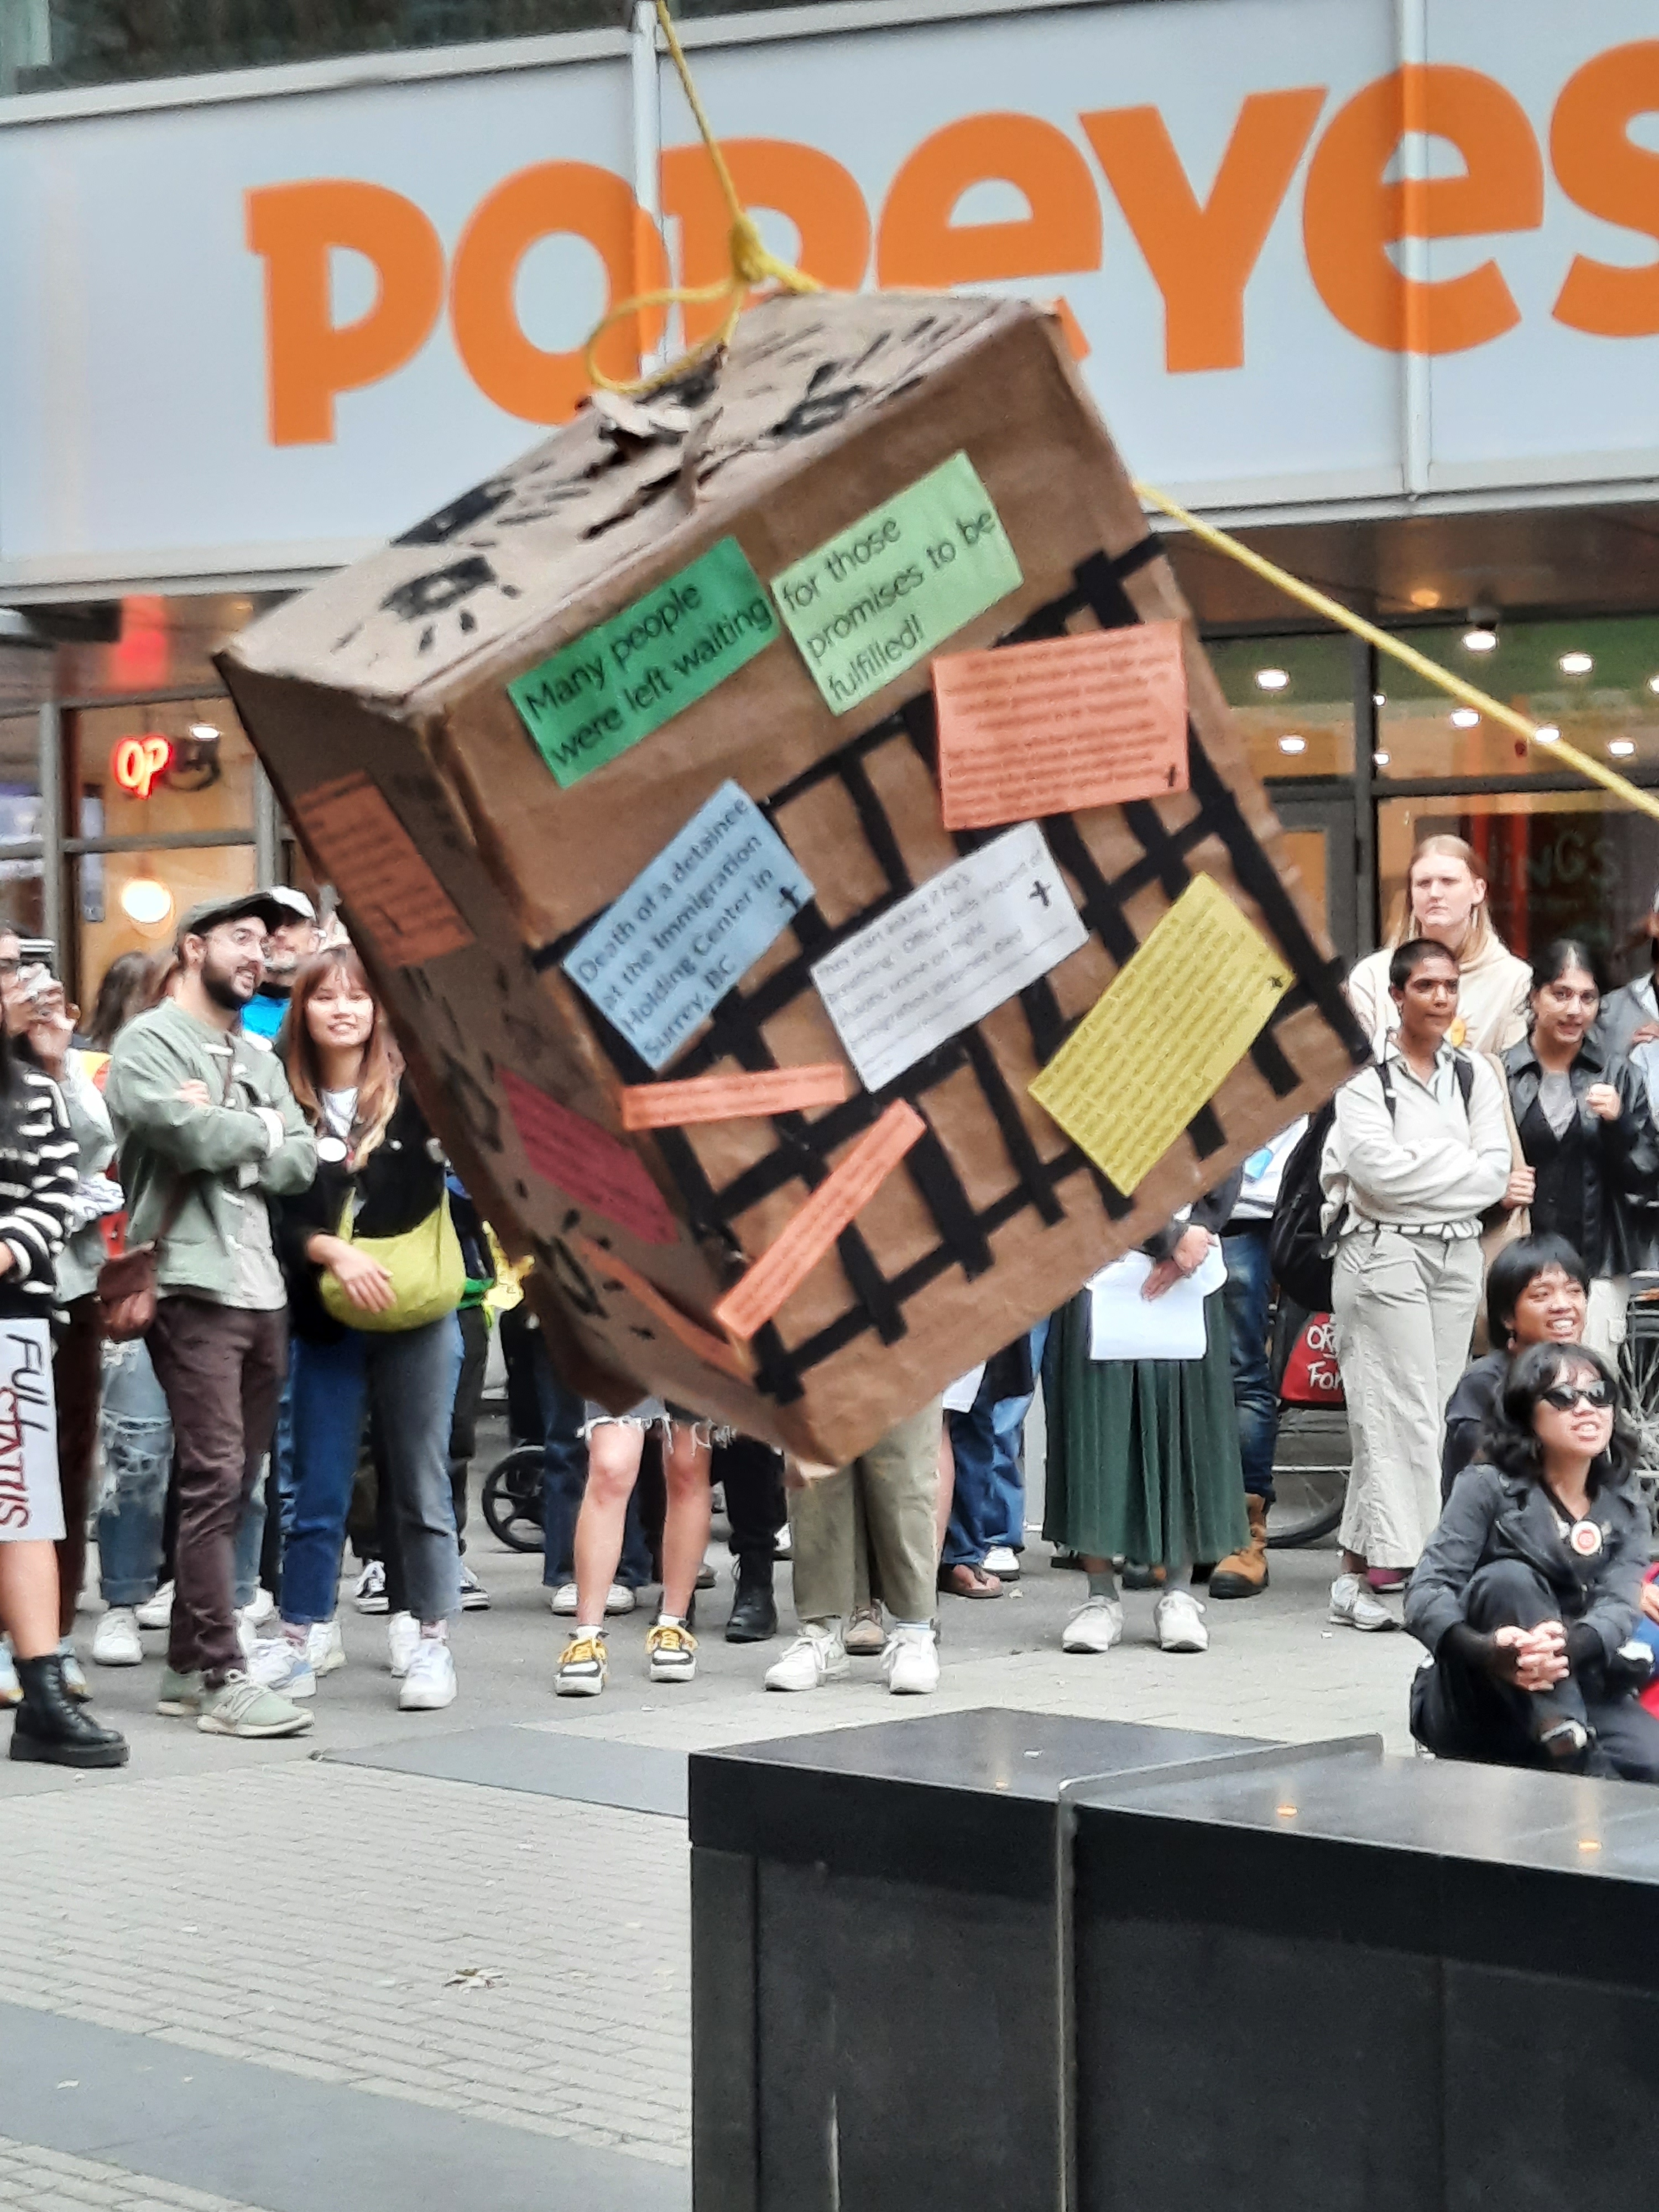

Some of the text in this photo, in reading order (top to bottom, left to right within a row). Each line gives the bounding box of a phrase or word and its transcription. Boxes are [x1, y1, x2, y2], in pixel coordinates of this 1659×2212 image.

[783, 517, 900, 612] for those
[807, 513, 995, 666] promises to be
[526, 583, 702, 723] Many people
[554, 597, 773, 766] were left waiting
[829, 613, 924, 701] fulfilled!
[578, 799, 749, 983] Death of a detainee
[622, 868, 773, 1035] Holding Center in
[623, 950, 655, 985] the
[652, 835, 763, 950] Immigration
[704, 954, 737, 990] BC
